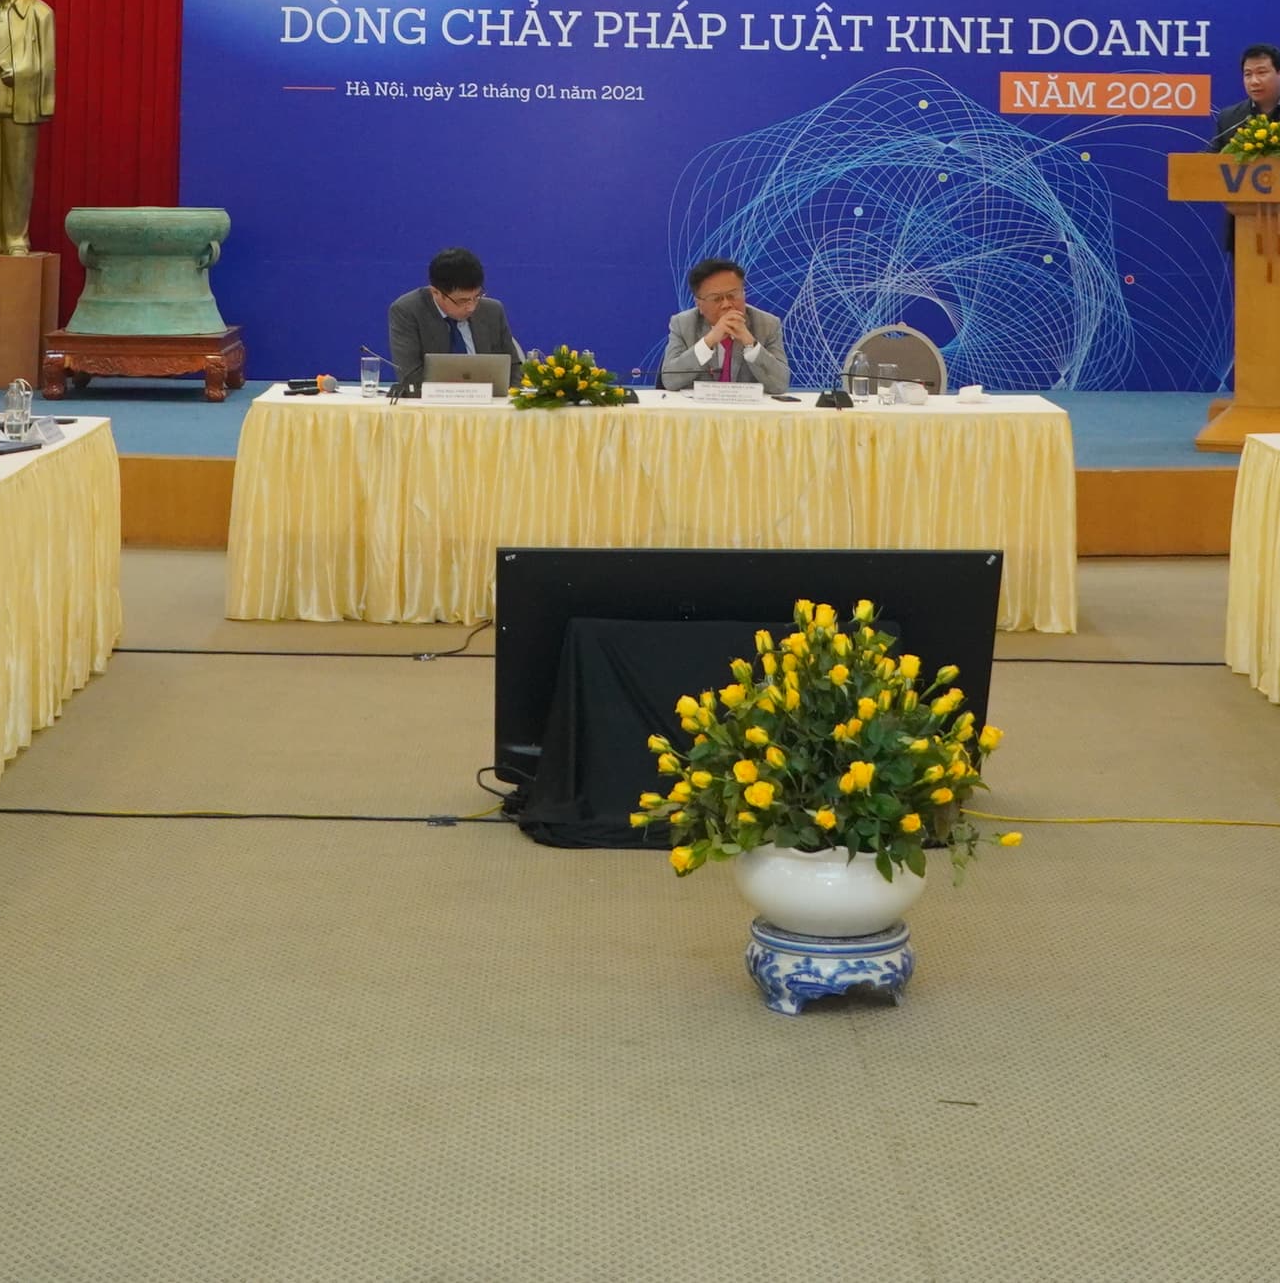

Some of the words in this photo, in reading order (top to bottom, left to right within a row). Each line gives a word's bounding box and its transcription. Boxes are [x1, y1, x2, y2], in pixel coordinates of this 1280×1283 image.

[594, 0, 727, 50] PHÁP
[740, 1, 872, 60] LUẬT
[886, 15, 1013, 55] KINH
[1028, 18, 1210, 57] DOANH
[345, 79, 370, 97] Hà
[374, 80, 408, 99] Nội,
[413, 81, 454, 102] ngày
[458, 82, 478, 98] 12
[482, 81, 531, 103] tháng
[536, 84, 556, 100] 01
[560, 84, 597, 100] năm
[601, 85, 645, 101] 2021
[1013, 72, 1096, 109] NĂM
[1106, 82, 1196, 110] 2020
